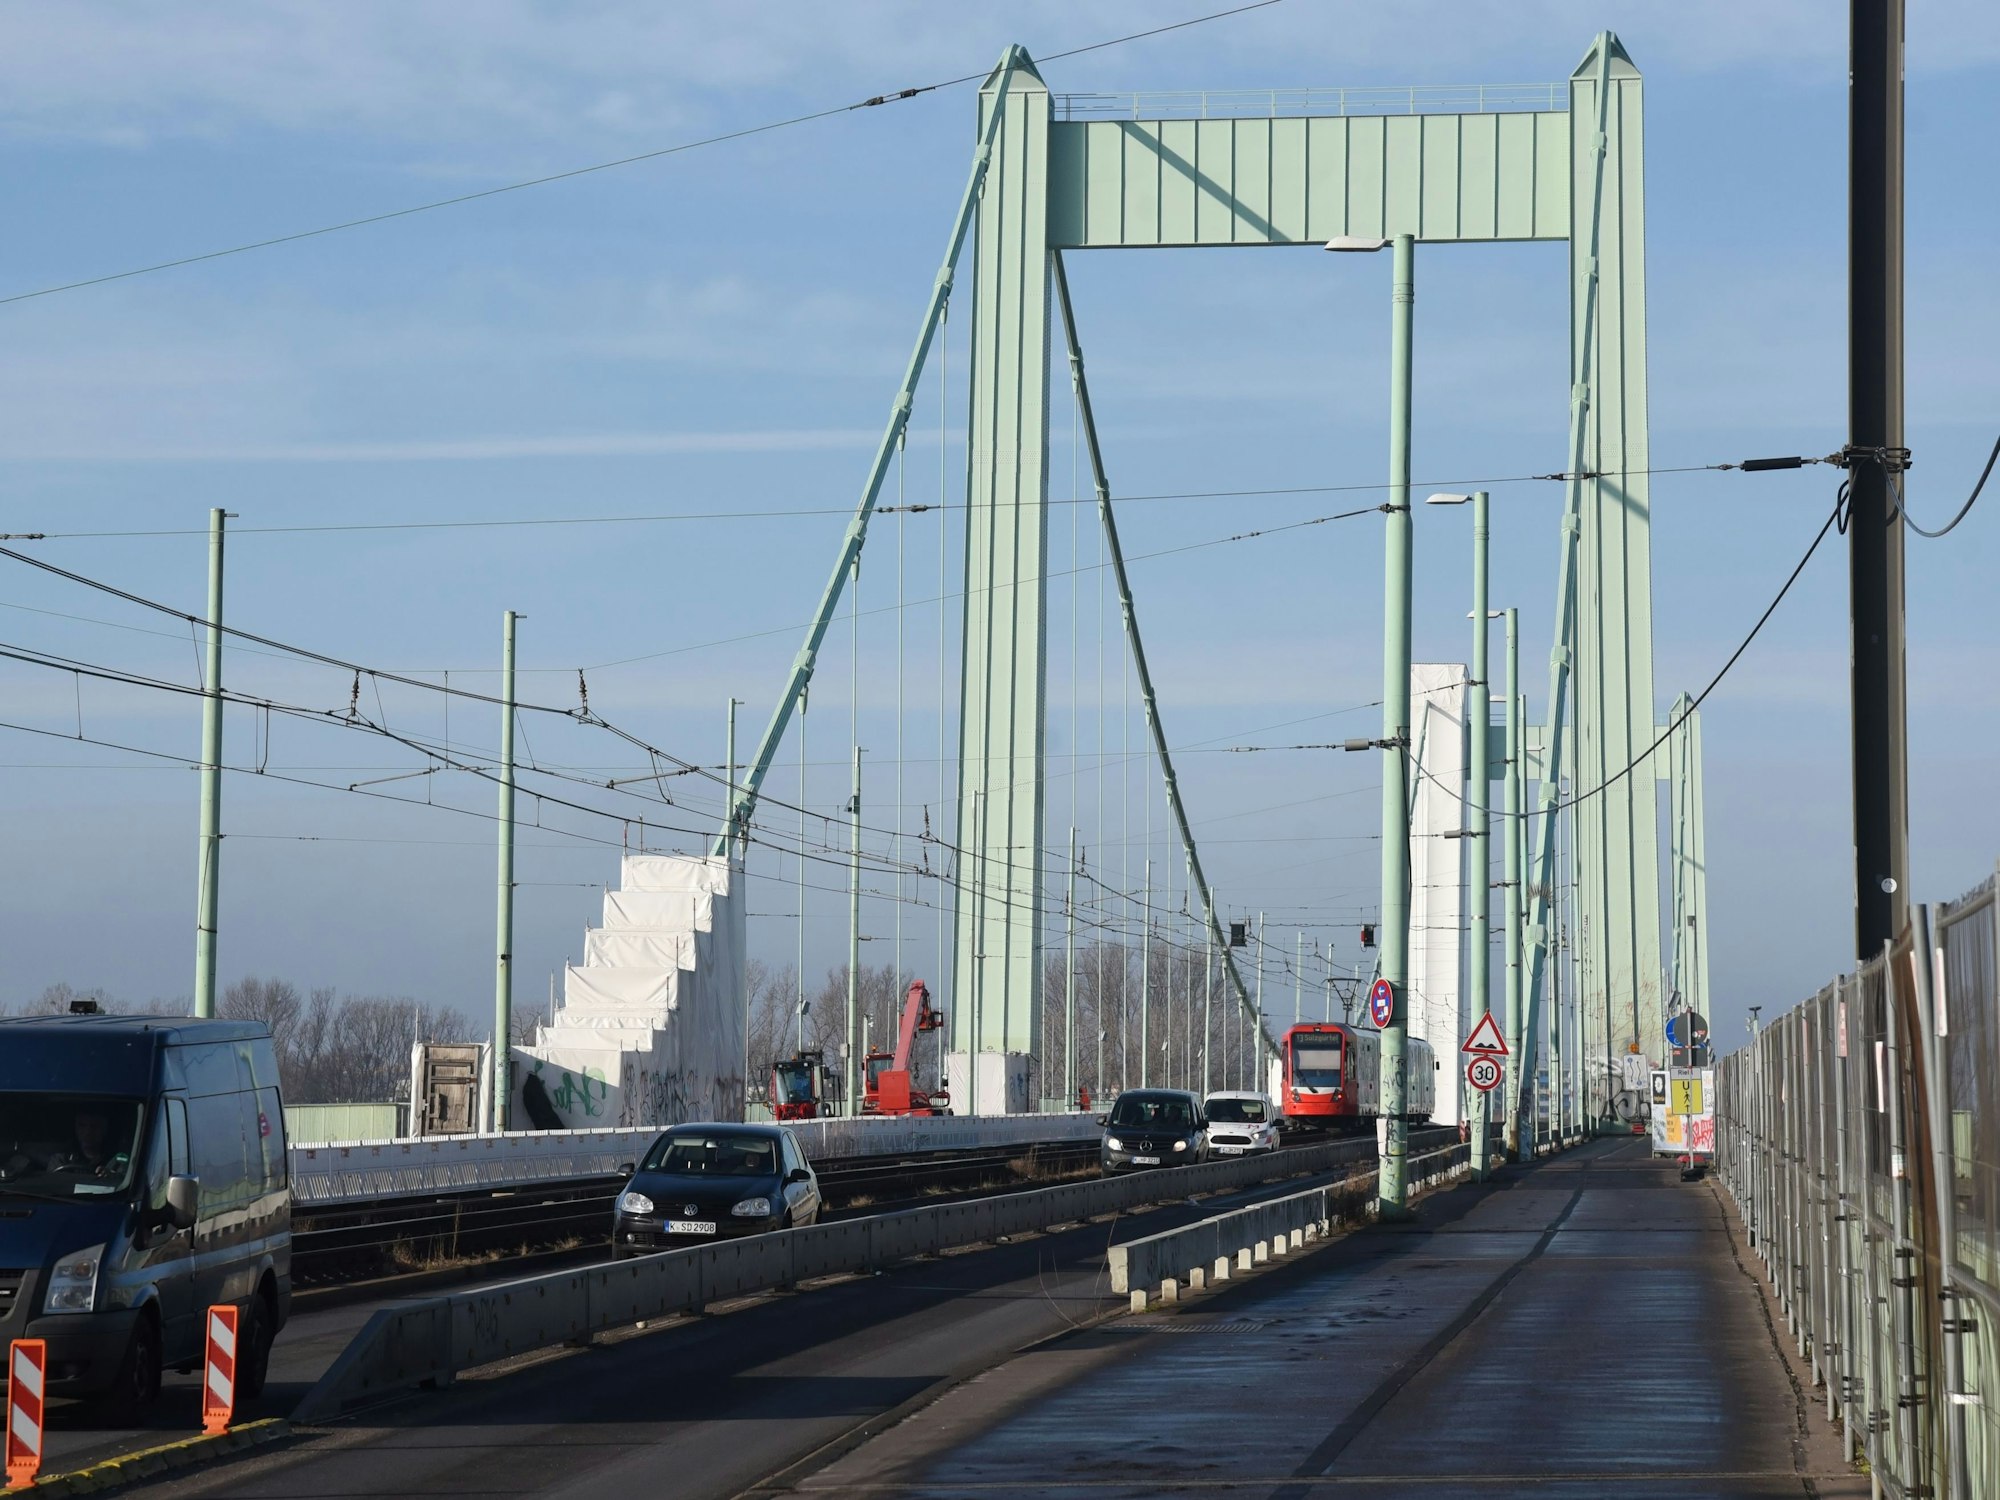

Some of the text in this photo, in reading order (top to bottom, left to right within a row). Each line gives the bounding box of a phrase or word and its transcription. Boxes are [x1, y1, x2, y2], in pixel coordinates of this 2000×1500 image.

[1475, 1065, 1494, 1081] 30
[1682, 1081, 1690, 1090] U
[669, 1222, 676, 1231] K
[693, 1223, 715, 1232] 2908
